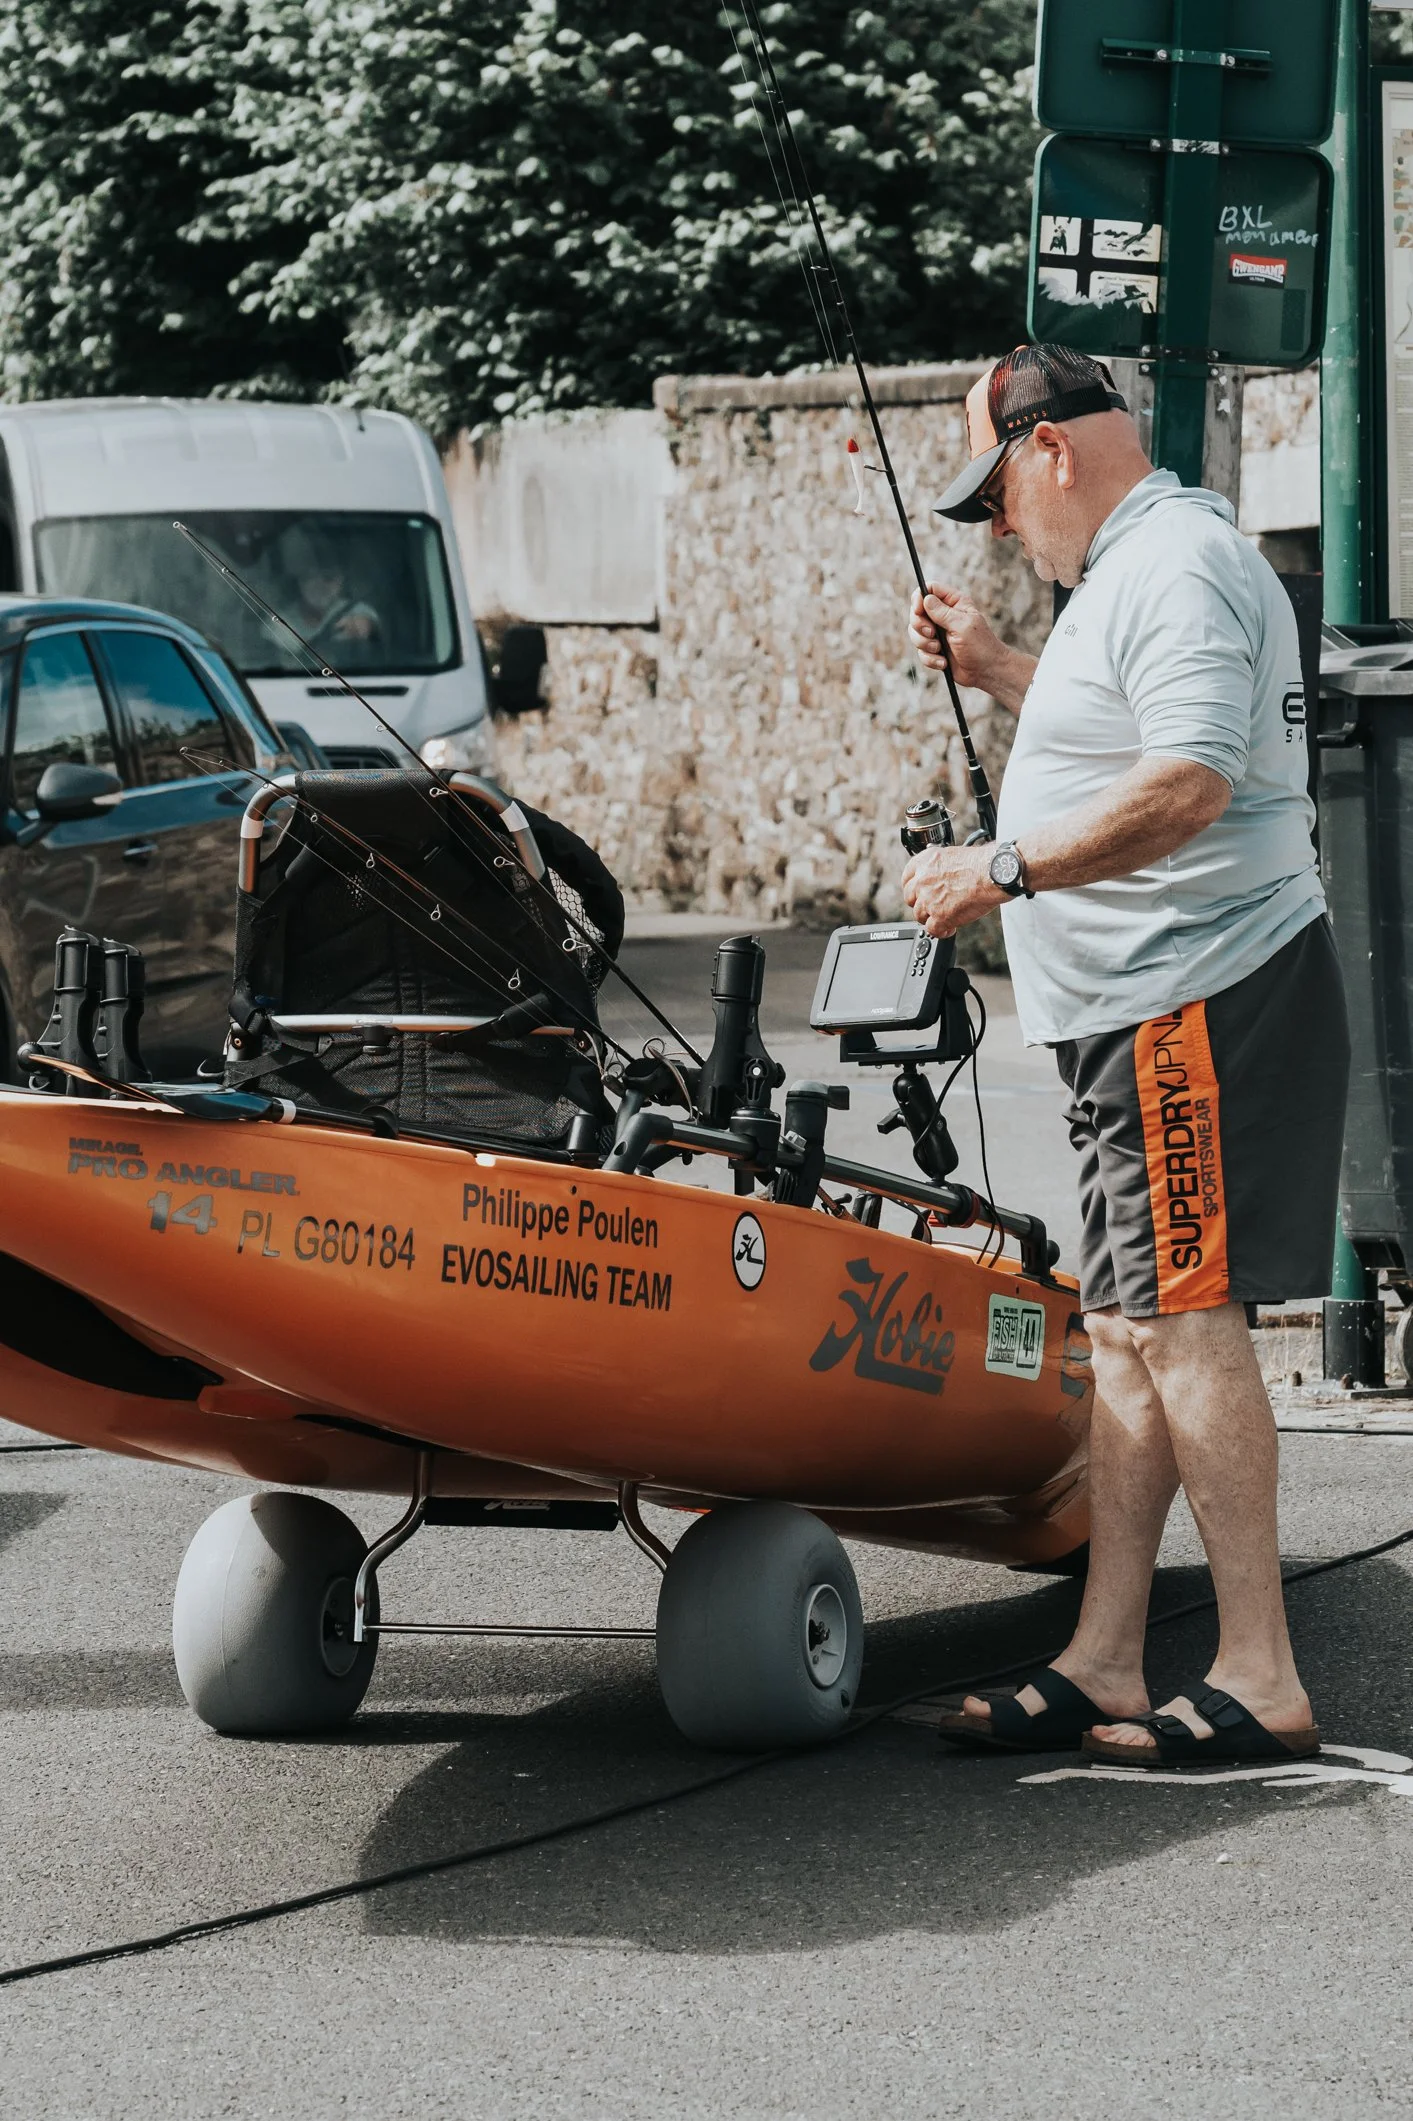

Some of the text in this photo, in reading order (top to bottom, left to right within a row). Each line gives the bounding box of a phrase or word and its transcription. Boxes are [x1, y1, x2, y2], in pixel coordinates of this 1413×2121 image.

[1218, 204, 1273, 232] BXL
[1007, 409, 1047, 429] WATTS
[67, 1151, 301, 1197] PRO ANGLER
[1195, 1097, 1219, 1218] SPORTSWEAR
[146, 1190, 219, 1236] 14
[236, 1209, 416, 1271] PL G80184
[462, 1182, 659, 1249] Philippe Poulen
[440, 1243, 673, 1312] EVOSAILING TEAM
